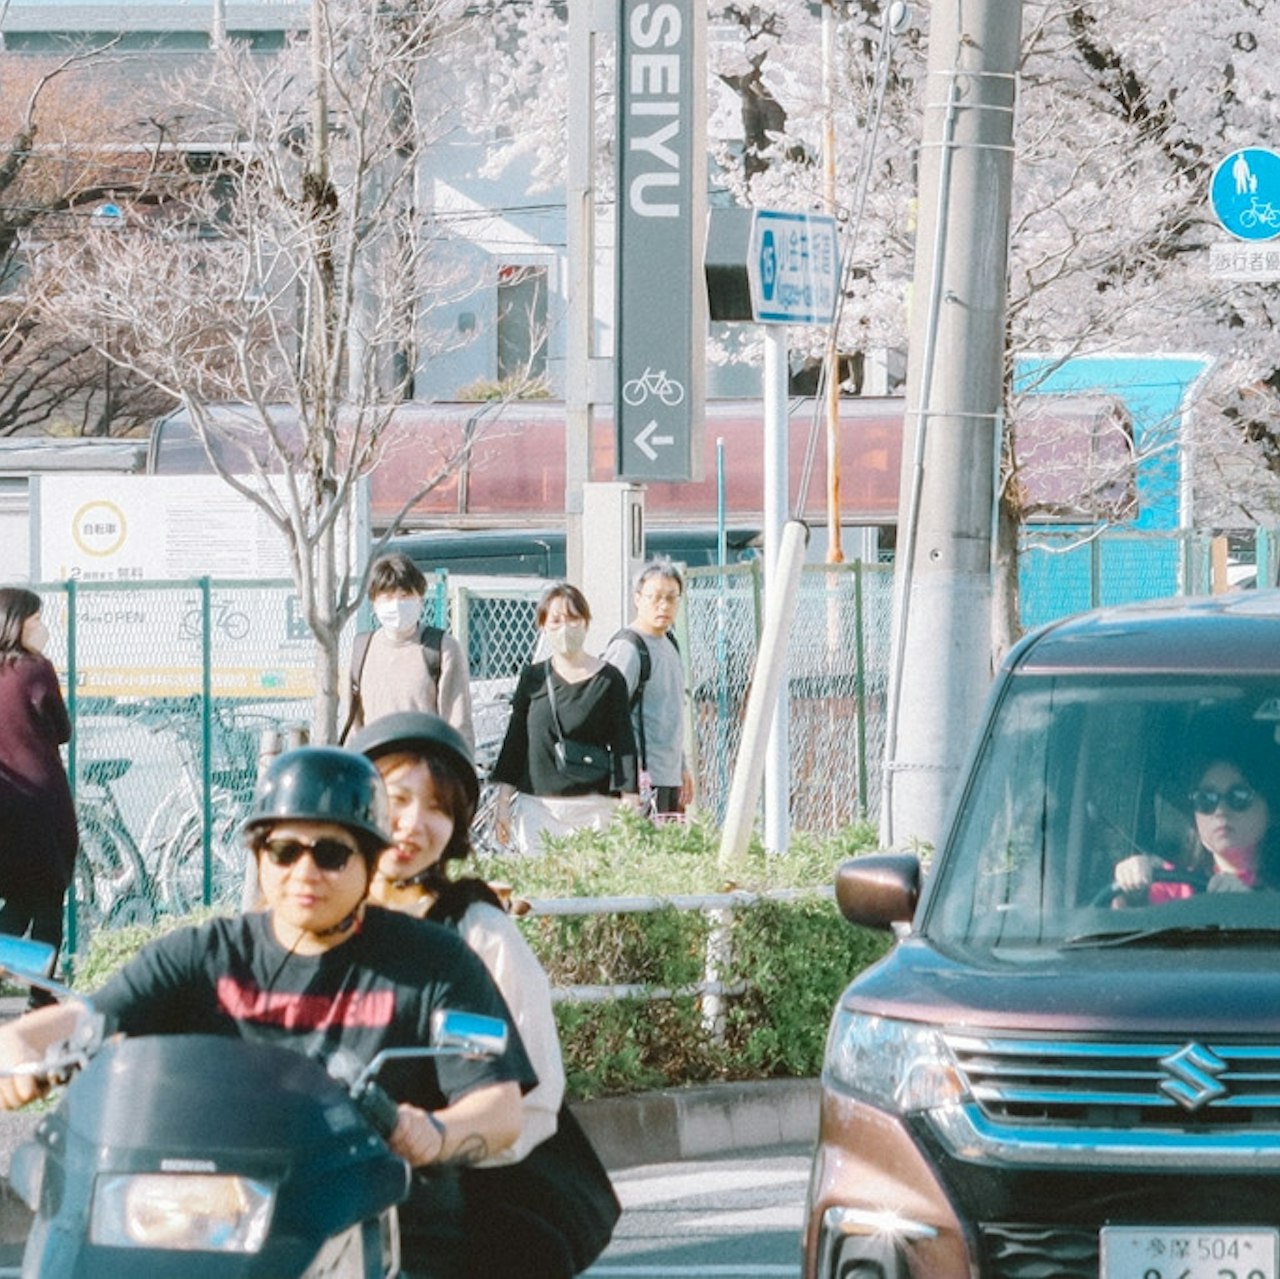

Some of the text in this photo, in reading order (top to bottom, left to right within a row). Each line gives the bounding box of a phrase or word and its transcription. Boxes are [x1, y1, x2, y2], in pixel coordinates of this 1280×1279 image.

[629, 2, 682, 218] SEIYU
[82, 522, 117, 537] 自転車
[1197, 1237, 1240, 1261] 504
